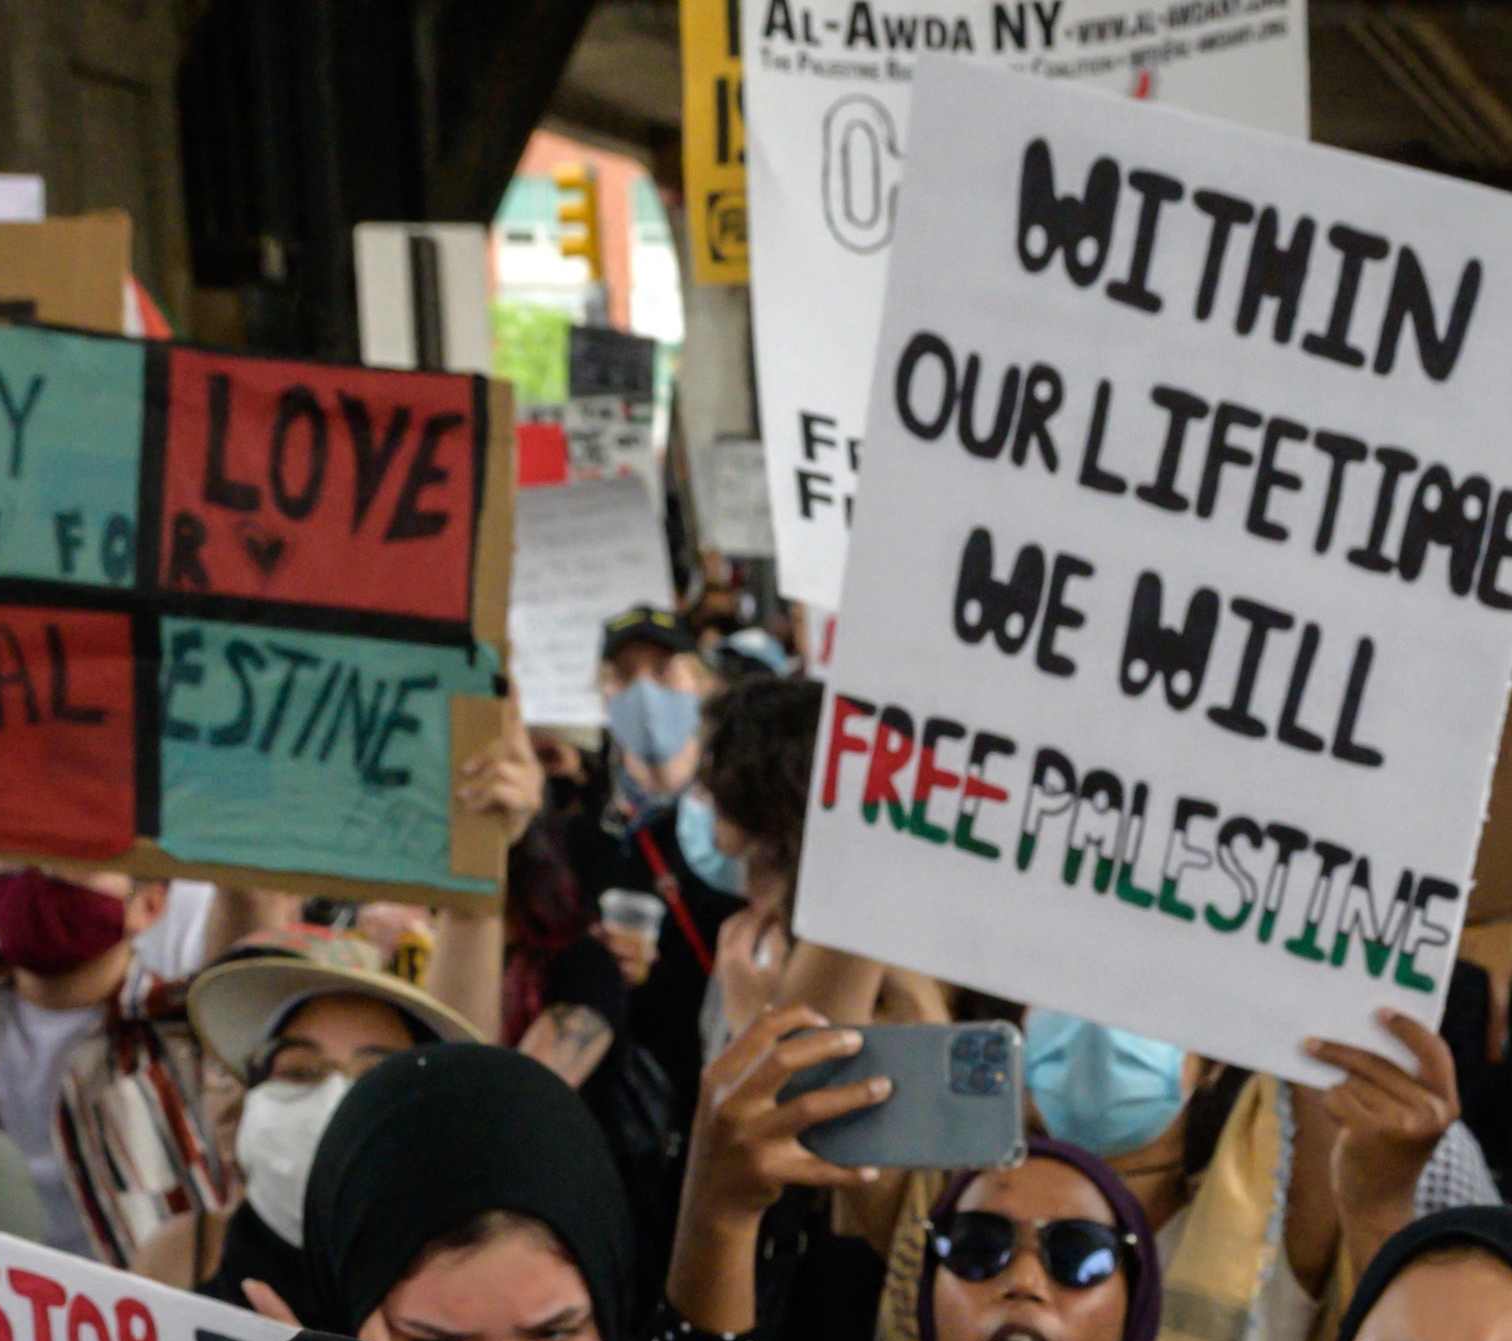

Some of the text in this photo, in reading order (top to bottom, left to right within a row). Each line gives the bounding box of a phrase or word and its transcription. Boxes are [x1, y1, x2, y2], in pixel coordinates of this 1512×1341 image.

[992, 3, 1062, 52] NY
[1017, 136, 1483, 384] WITHIN
[203, 371, 468, 546] LOVE
[896, 330, 1062, 476] OUR
[53, 510, 214, 596] FOR
[952, 524, 1385, 769] WE WILL
[821, 693, 1462, 996] FREE PALESTINE
